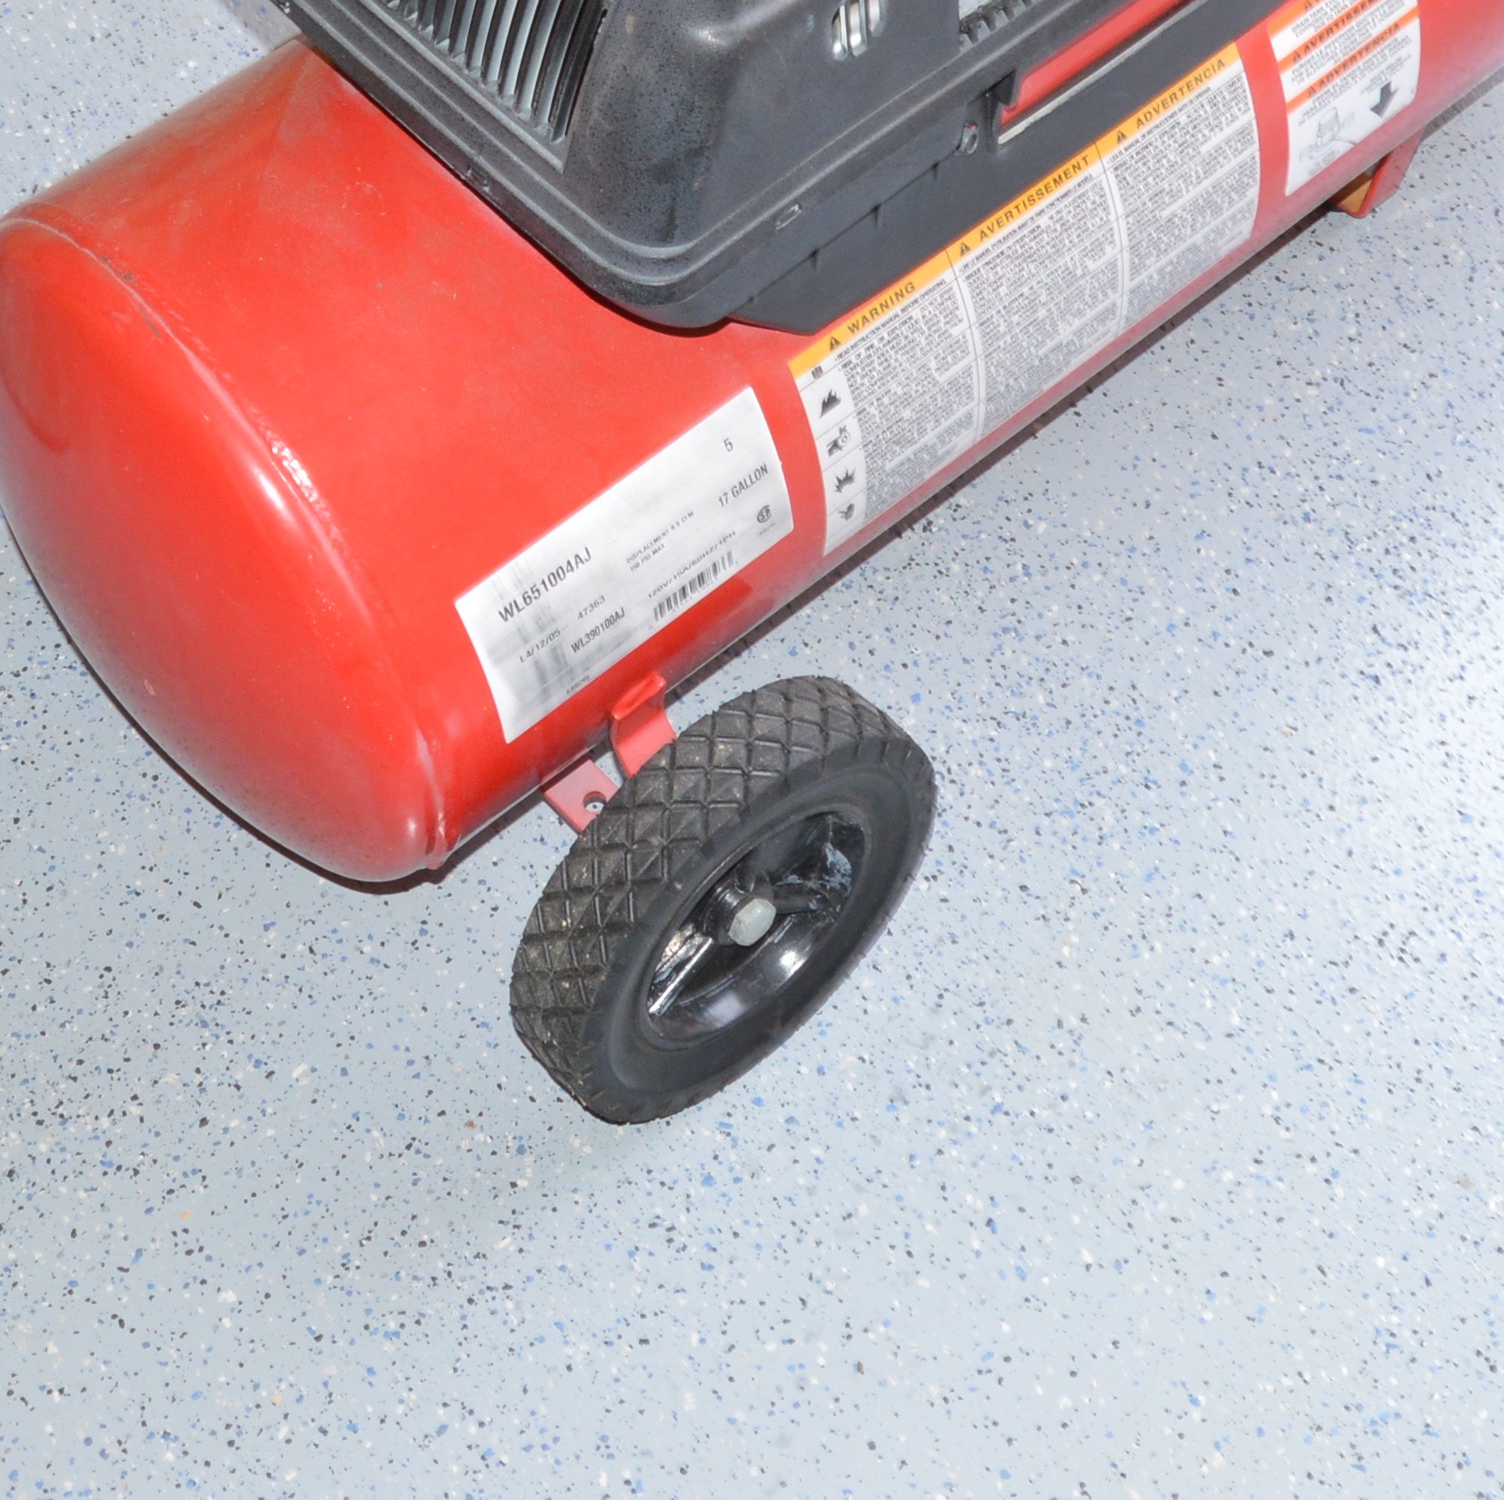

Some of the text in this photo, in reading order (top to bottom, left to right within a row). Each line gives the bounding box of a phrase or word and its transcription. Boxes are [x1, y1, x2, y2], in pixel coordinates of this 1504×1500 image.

[1136, 59, 1226, 129] ADVERTENCIA
[979, 155, 1089, 242] AVERTISSEMENT
[847, 281, 916, 334] WARNING
[723, 438, 734, 452] 5
[718, 463, 769, 507] 17 GALLON
[626, 530, 669, 564] DISPLACEMENT
[498, 547, 592, 623] WL651004AJ
[577, 595, 606, 620] 47363
[570, 607, 626, 653] WL390100AJ
